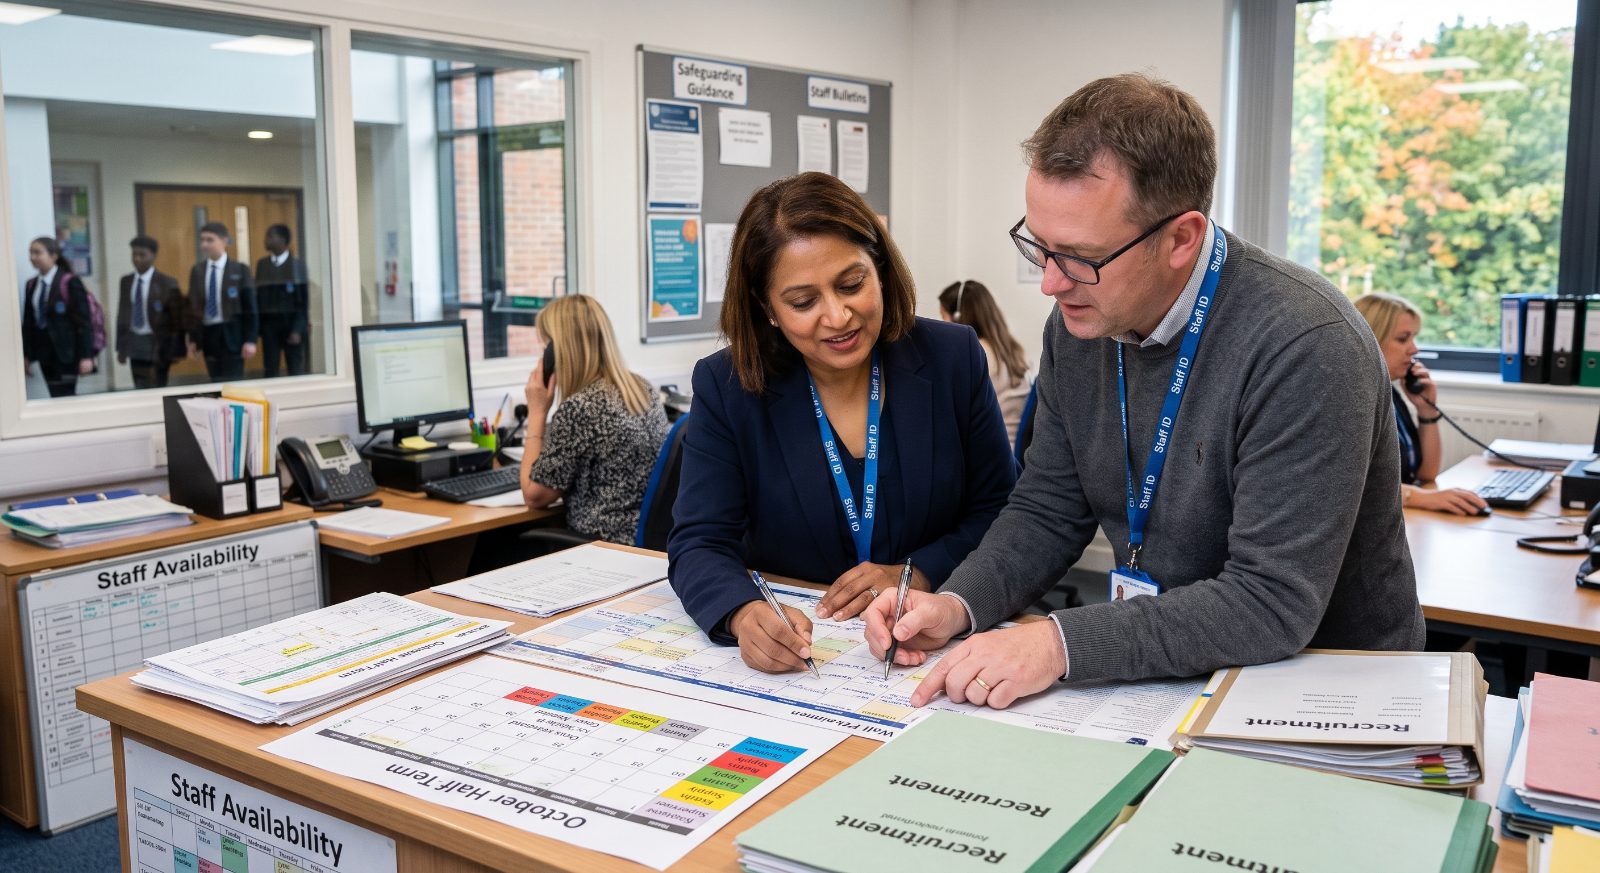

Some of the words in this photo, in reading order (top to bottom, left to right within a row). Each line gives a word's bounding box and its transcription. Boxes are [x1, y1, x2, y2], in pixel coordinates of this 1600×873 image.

[678, 63, 743, 85] Safeguarding
[687, 83, 734, 100] Guidance
[811, 85, 831, 97] Staff
[833, 89, 867, 103] Bulletins
[1216, 238, 1224, 249] ID
[1210, 249, 1223, 272] Staff
[1189, 308, 1205, 334] Staff
[1198, 296, 1209, 307] ID
[1171, 369, 1185, 395] Staff
[1178, 357, 1189, 370] ID
[868, 424, 877, 434] ID
[1161, 416, 1171, 428] ID
[868, 436, 877, 460] Staff
[1154, 429, 1169, 453] Staff
[825, 440, 838, 463] Staff
[833, 463, 842, 474] ID
[866, 484, 874, 494] ID
[1145, 475, 1155, 485] ID
[864, 494, 874, 519] Staff
[1139, 486, 1152, 509] Staff
[844, 498, 856, 520] Staff
[851, 520, 860, 532] ID
[98, 564, 146, 589] Staff
[153, 544, 259, 578] Availability
[862, 725, 894, 738] Wall
[1245, 717, 1410, 734] Recruitment
[709, 770, 749, 783] Supply
[686, 786, 726, 799] Supply
[888, 774, 1052, 818] Recruitment
[171, 773, 216, 811] Staff
[222, 793, 343, 867] Availability
[490, 795, 587, 829] October
[834, 814, 1007, 864] Recruitment
